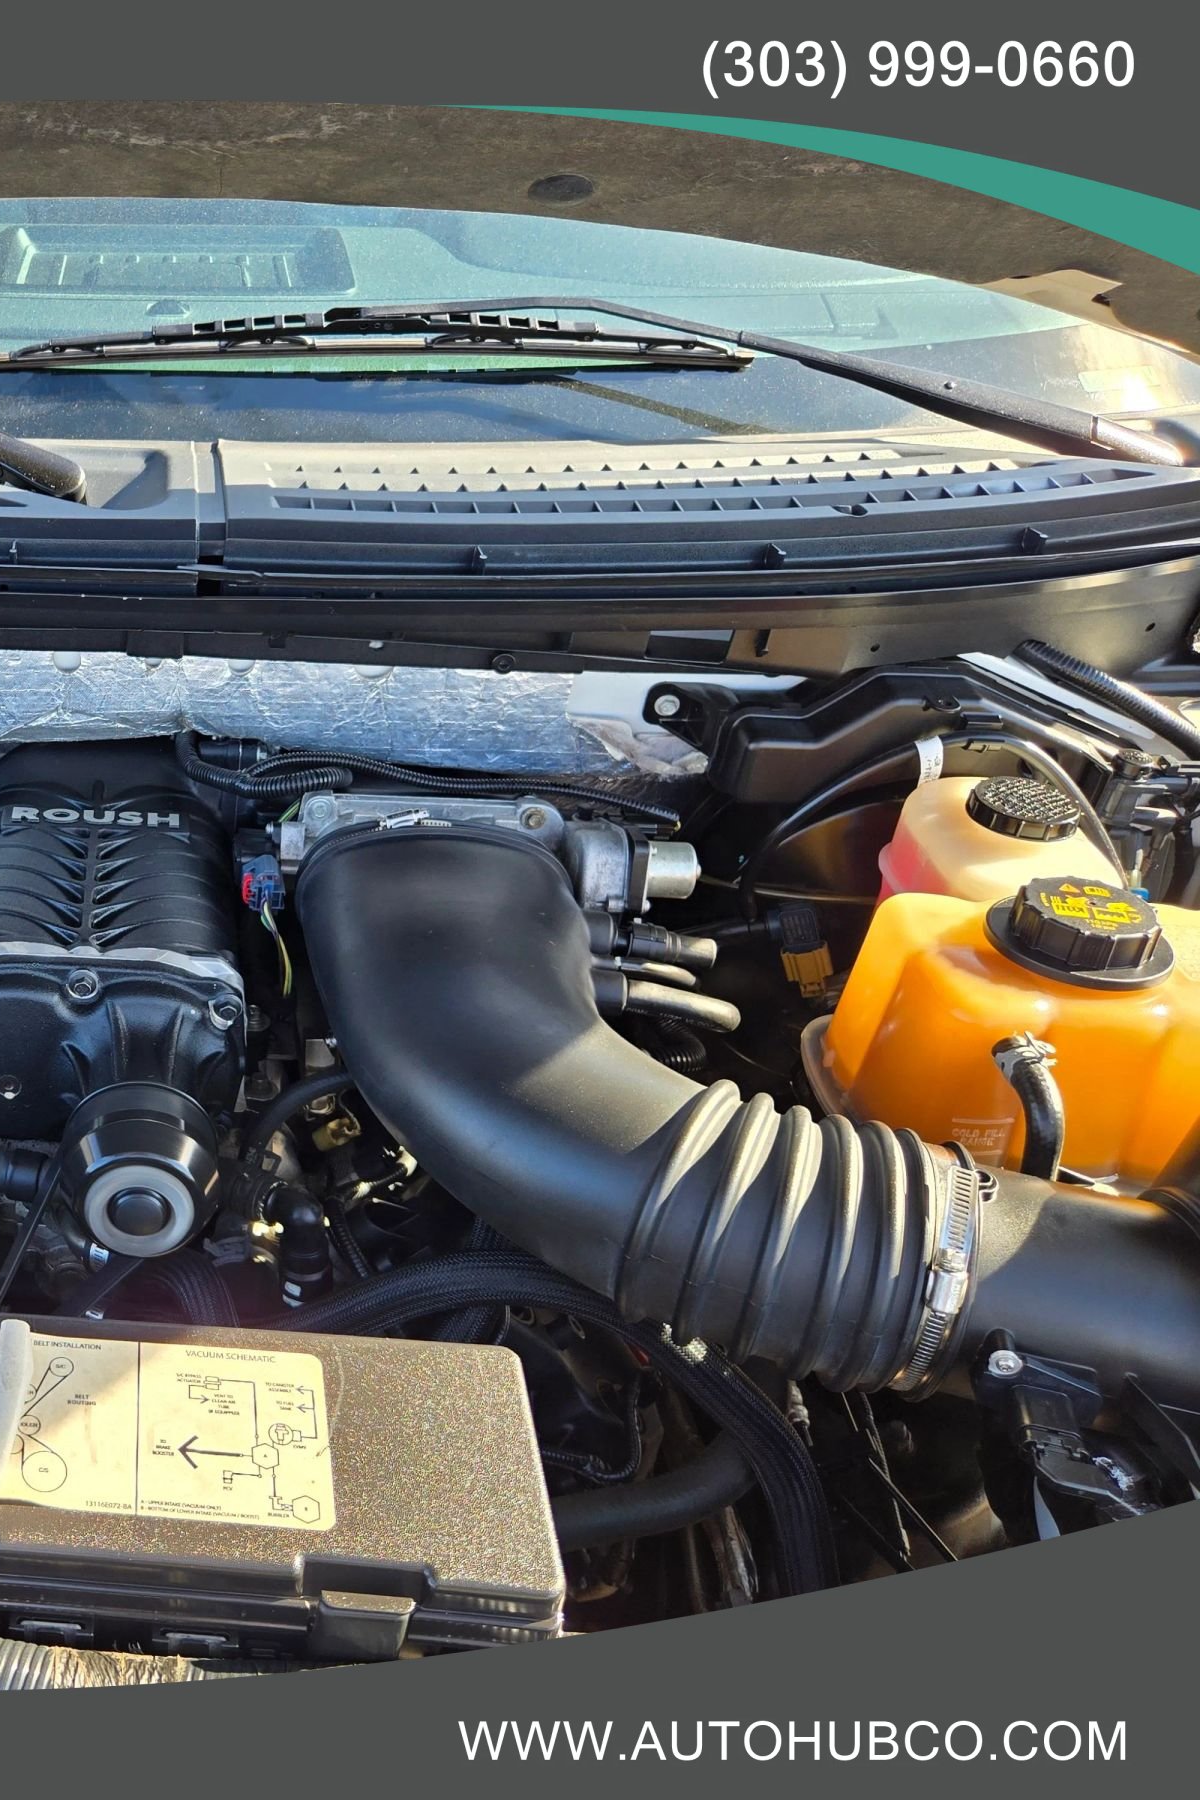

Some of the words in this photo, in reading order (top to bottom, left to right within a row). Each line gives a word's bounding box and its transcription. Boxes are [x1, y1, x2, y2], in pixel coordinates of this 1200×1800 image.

[11, 806, 180, 828] ROUSH
[951, 1128, 980, 1137] COLD
[984, 1128, 1006, 1137] FILL
[960, 1137, 995, 1146] RANGE
[50, 1341, 102, 1350] INSTALLATION
[185, 1350, 224, 1360] VACUUM
[226, 1353, 277, 1364] SCHEMATIC
